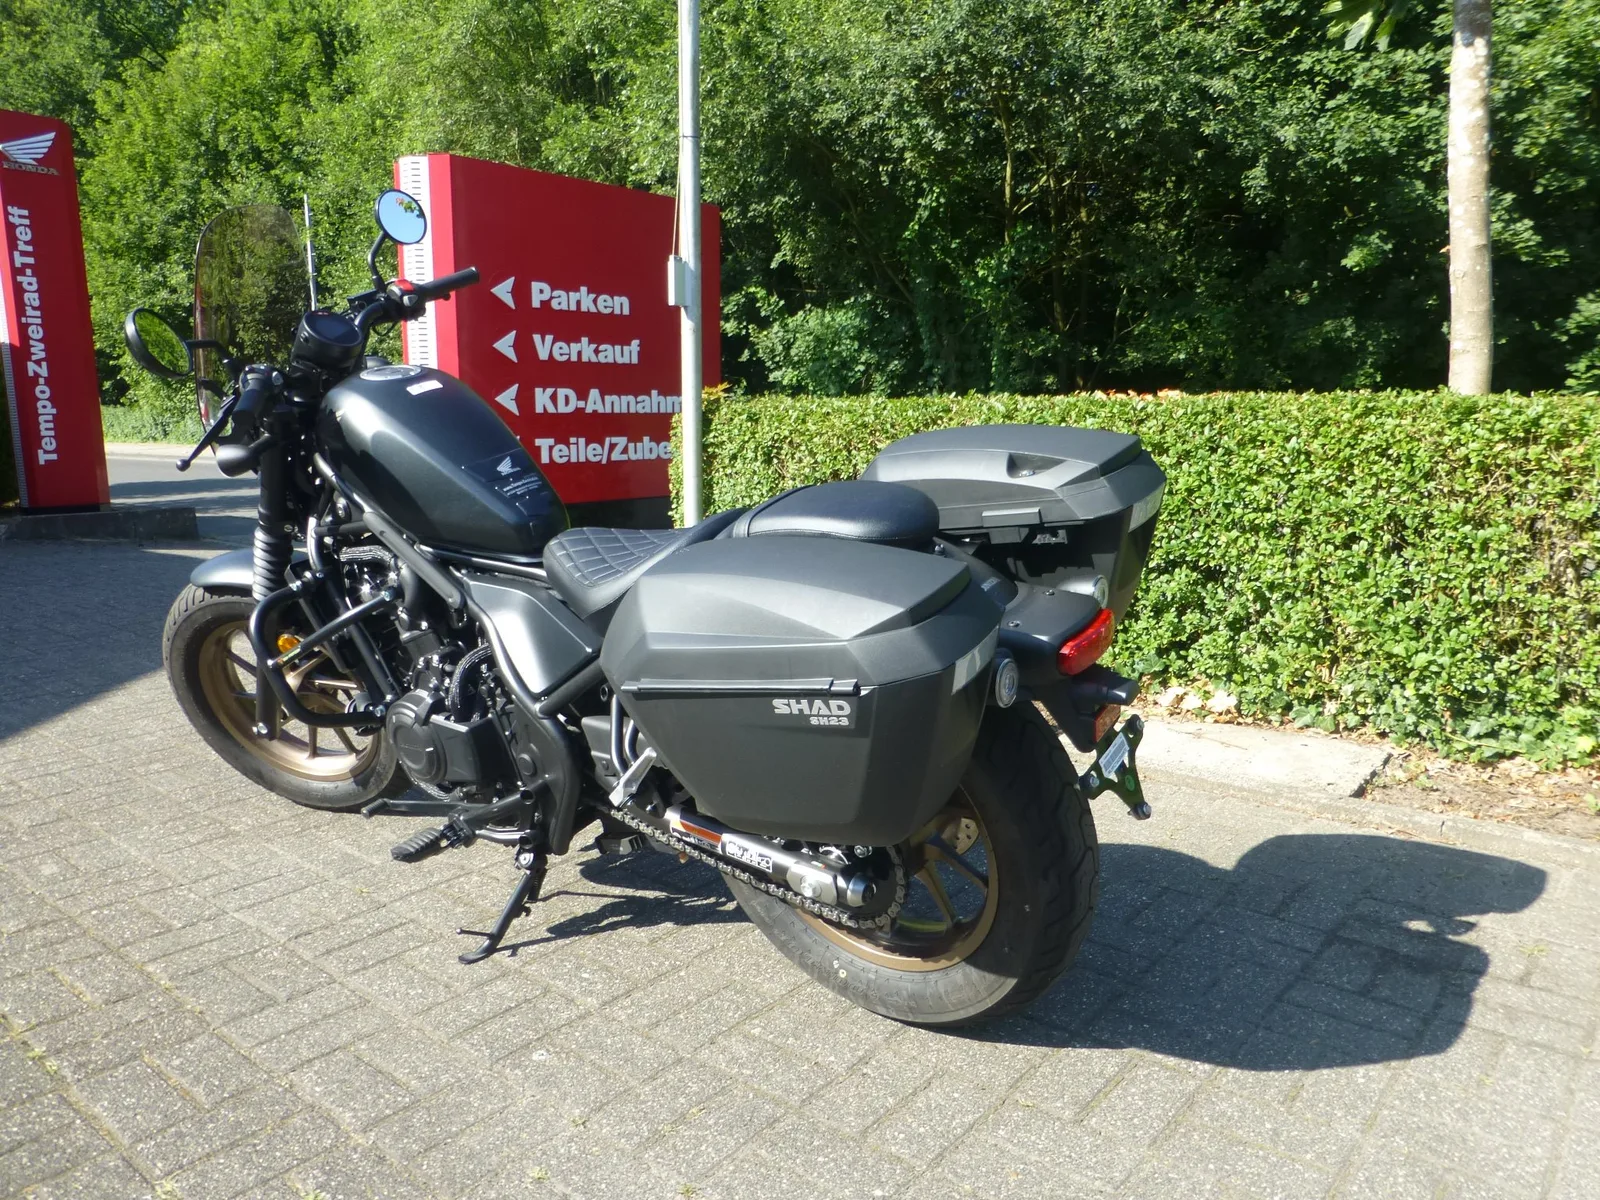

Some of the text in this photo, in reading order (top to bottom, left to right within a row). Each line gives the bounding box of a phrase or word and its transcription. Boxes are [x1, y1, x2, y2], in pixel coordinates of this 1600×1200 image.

[3, 161, 60, 176] HONDA
[531, 281, 630, 315] Parken
[7, 205, 59, 465] Tempo-Zweirad-Treff
[532, 334, 640, 364] Verkauf
[772, 699, 851, 715] SHAD
[809, 716, 849, 726] SH23
